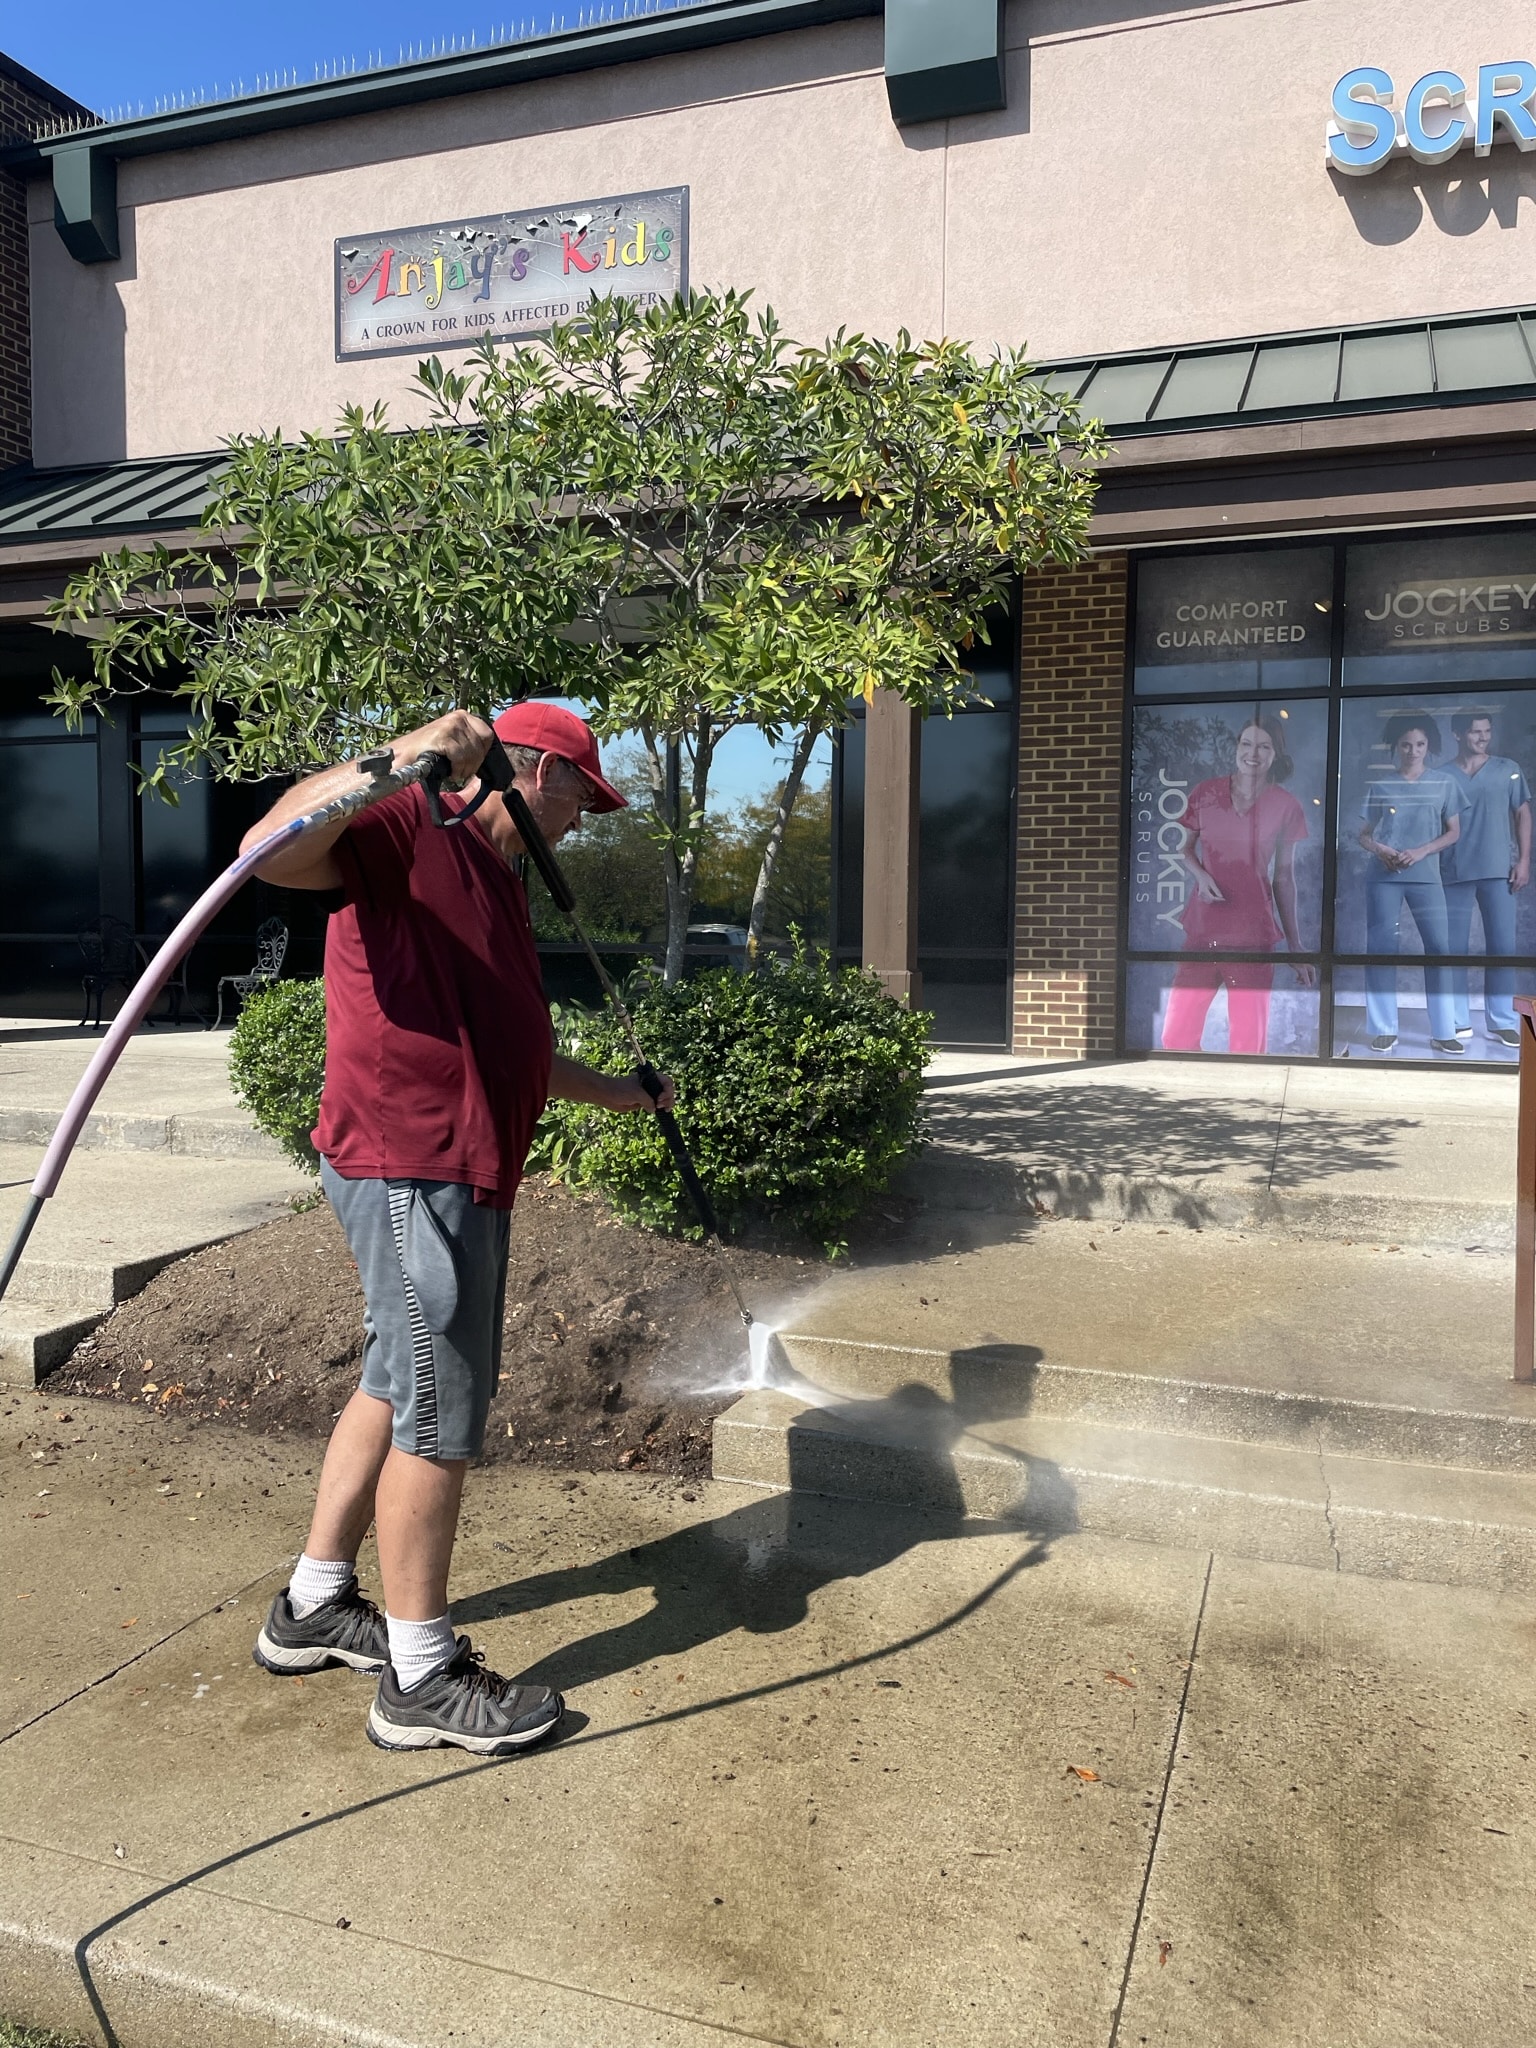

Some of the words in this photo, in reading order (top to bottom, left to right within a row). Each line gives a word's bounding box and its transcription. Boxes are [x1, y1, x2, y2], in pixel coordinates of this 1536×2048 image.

[1328, 60, 1536, 170] SCR
[347, 234, 531, 310] Anjay's
[559, 221, 674, 275] Kids
[361, 327, 370, 340] A
[376, 320, 426, 338] CROWN
[432, 317, 458, 332] FOR
[464, 312, 496, 327] KIDS
[502, 302, 570, 324] AFFECTED
[1156, 624, 1307, 649] GUARANTEED
[1176, 600, 1288, 622] COMFORT
[1394, 617, 1511, 638] SCRUBS
[1136, 792, 1152, 903] SCRUBS
[1156, 768, 1188, 930] JOCKEY
